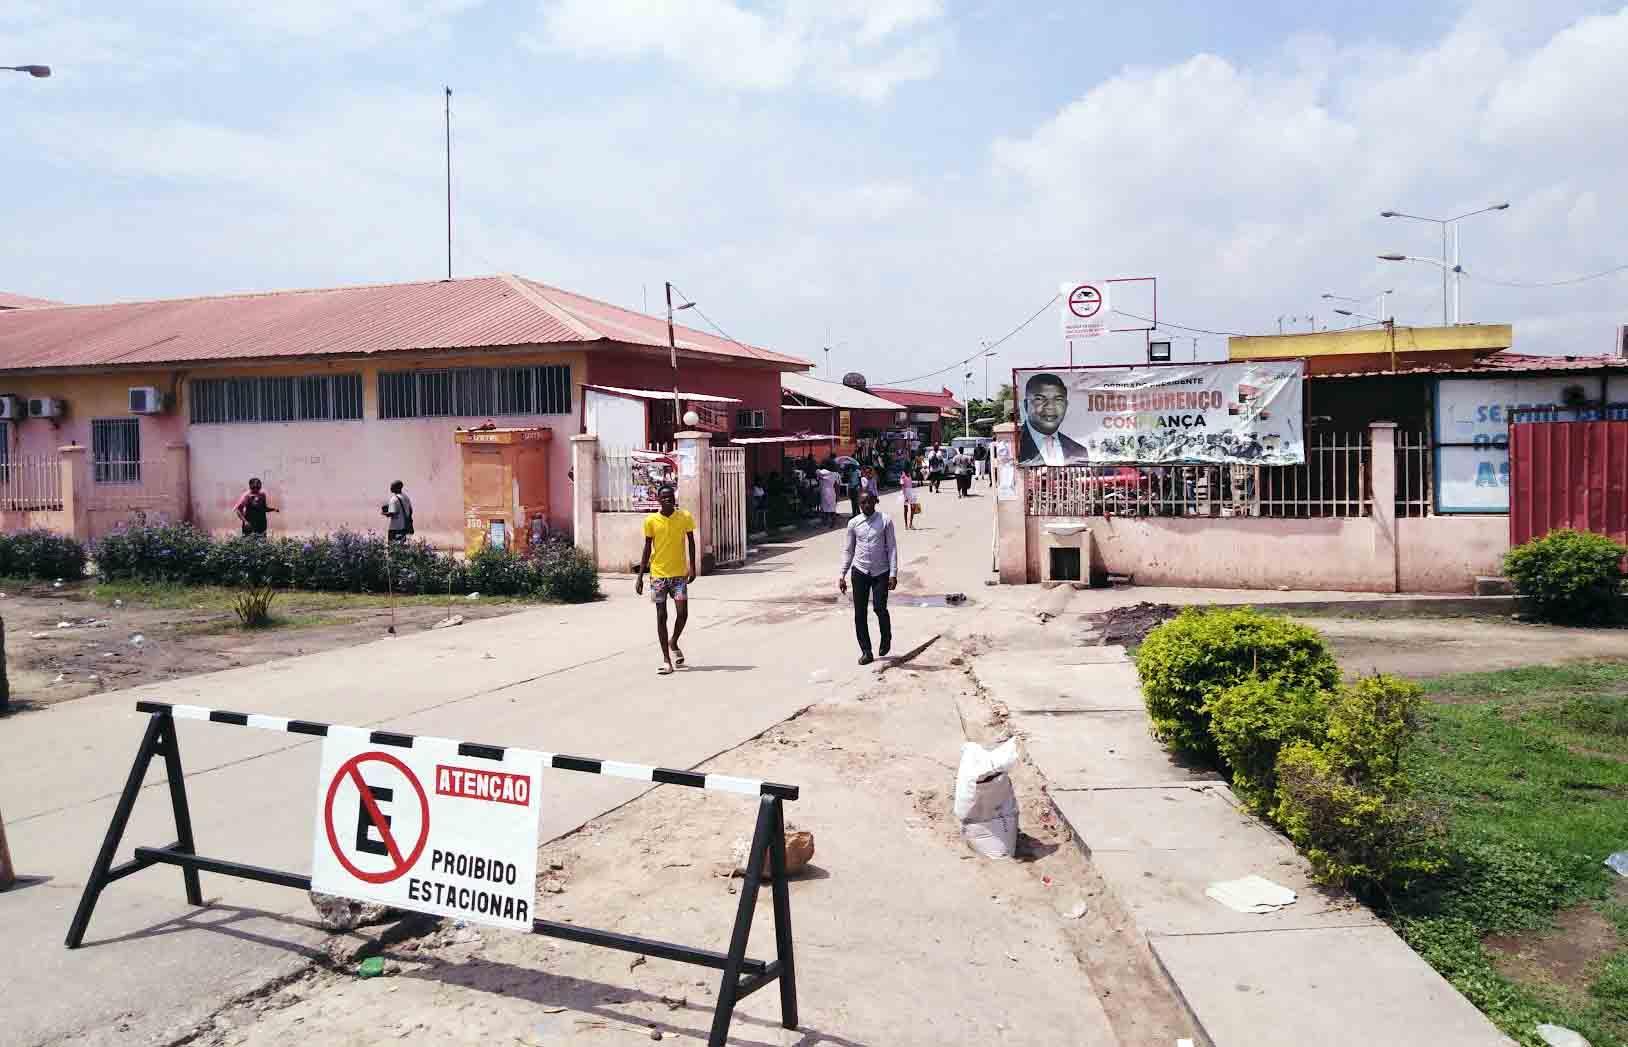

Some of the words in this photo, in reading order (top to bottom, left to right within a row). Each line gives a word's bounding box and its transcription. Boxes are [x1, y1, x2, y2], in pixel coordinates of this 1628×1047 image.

[1103, 414, 1206, 429] CONANÇA
[356, 785, 393, 856] E
[431, 849, 516, 885] PROIBIDO
[408, 878, 528, 922] ESTACIONAR
